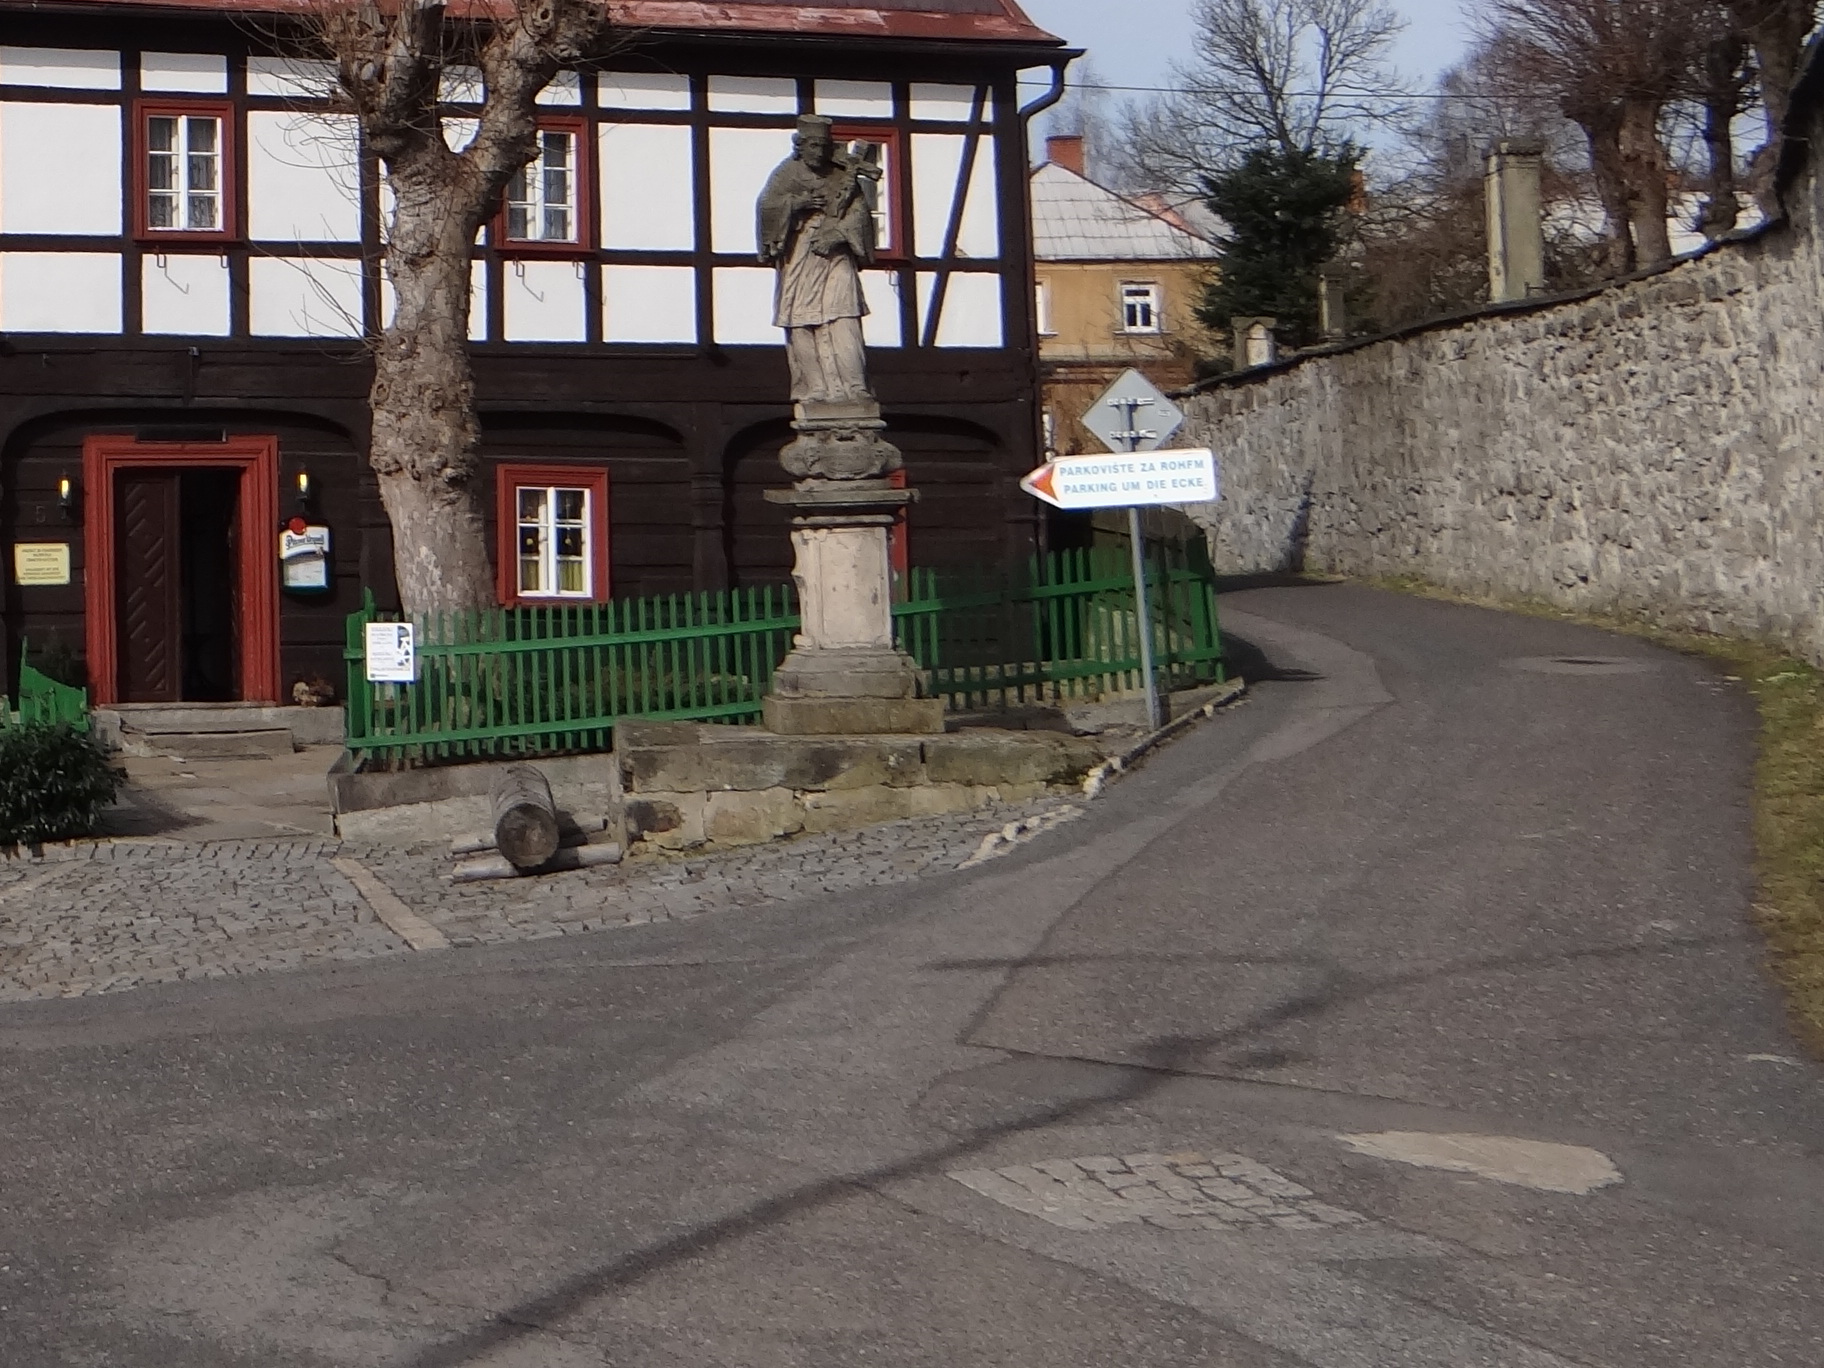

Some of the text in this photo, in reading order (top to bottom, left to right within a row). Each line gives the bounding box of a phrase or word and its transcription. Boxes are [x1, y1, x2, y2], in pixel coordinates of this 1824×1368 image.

[1140, 462, 1156, 473] ZA
[1064, 477, 1204, 494] PARKING UM DIE ECKE
